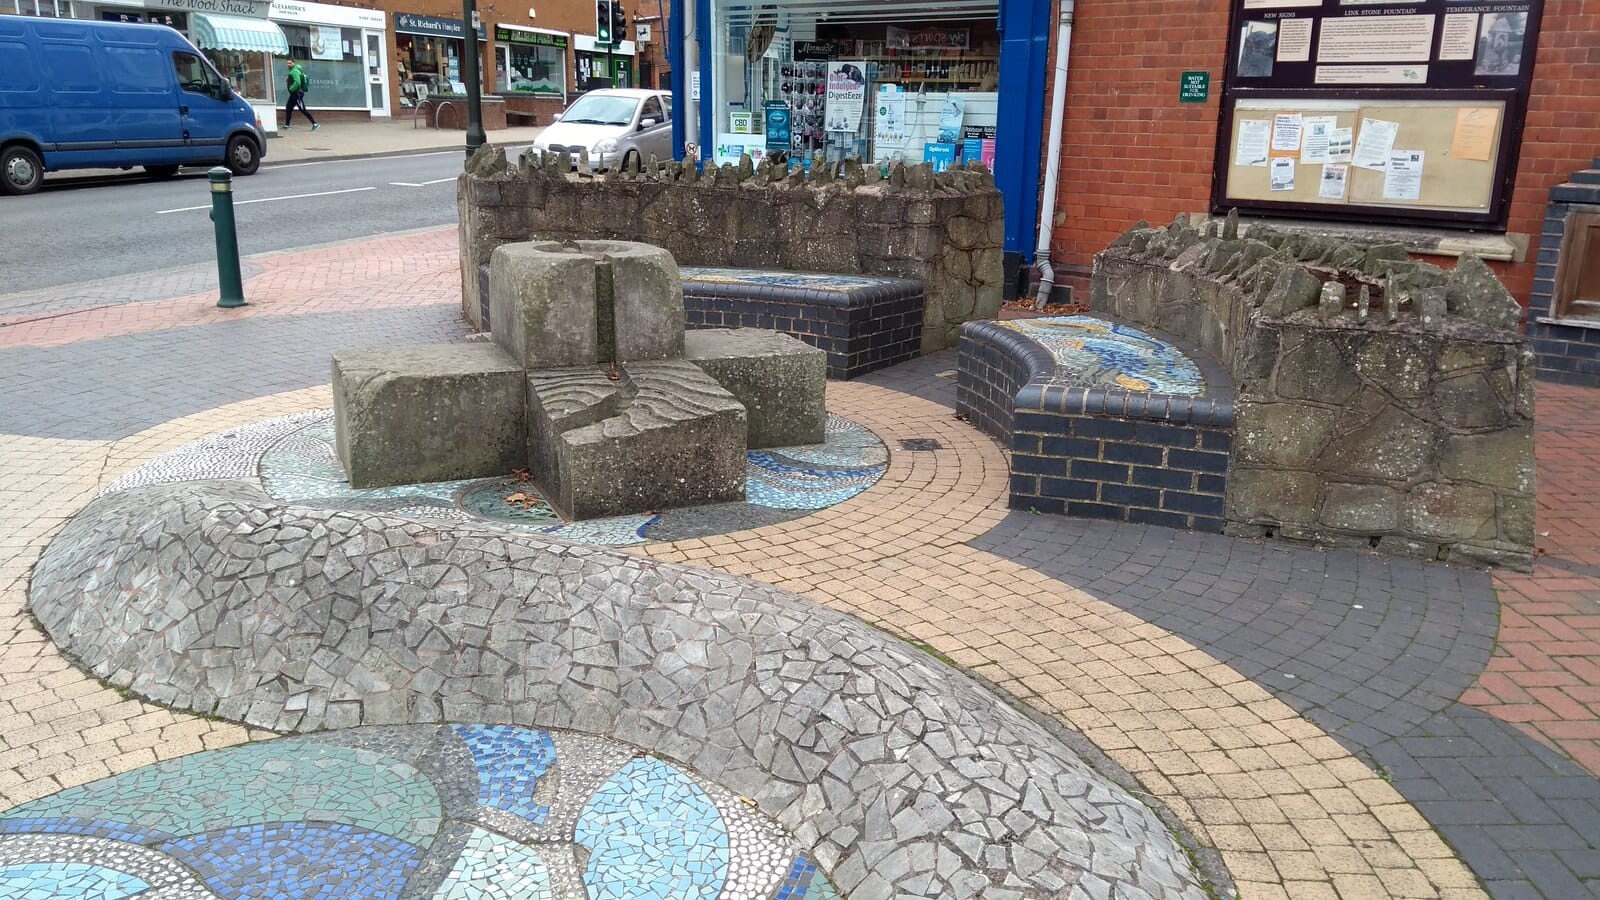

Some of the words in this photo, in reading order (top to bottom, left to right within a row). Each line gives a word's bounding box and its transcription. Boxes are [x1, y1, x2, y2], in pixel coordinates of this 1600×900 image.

[187, 0, 219, 11] Wool
[220, 0, 257, 14] Shack
[272, 3, 306, 12] ALEXANDRA'S
[409, 19, 417, 27] St.
[417, 20, 442, 30] Richard's
[828, 91, 863, 100] DigestEeze
[734, 119, 748, 127] CBD
